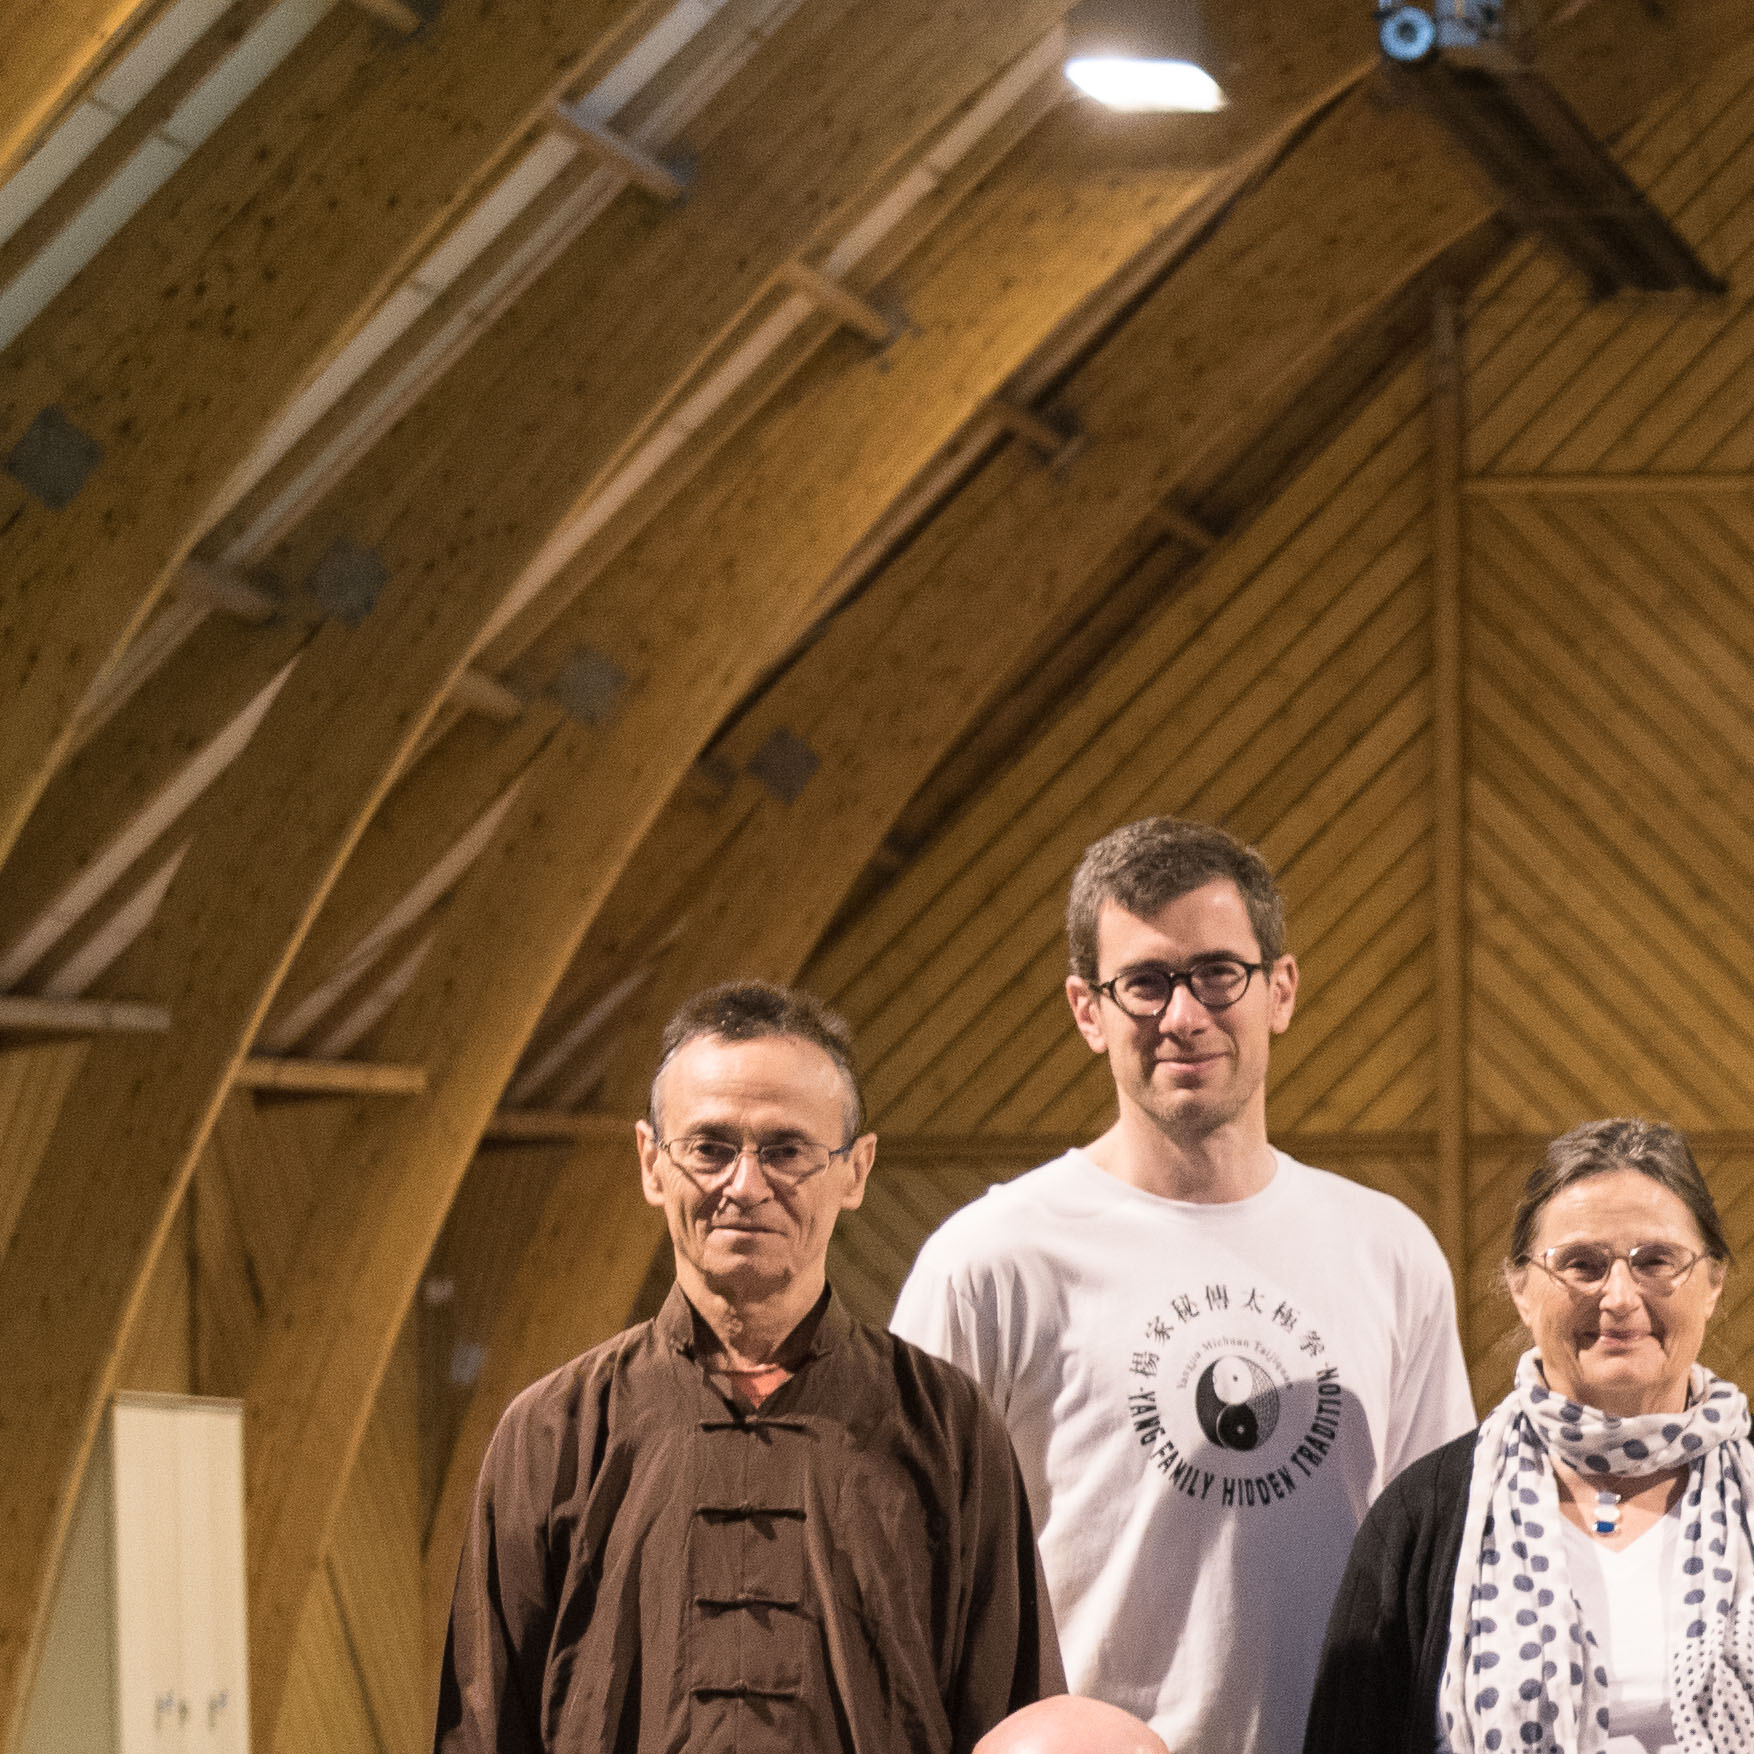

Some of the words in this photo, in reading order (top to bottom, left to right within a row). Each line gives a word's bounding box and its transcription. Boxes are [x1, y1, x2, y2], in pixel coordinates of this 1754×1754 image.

[1128, 1389, 1166, 1446] YANG
[1151, 1440, 1214, 1500] FAMILY
[1221, 1464, 1298, 1507] HIDDEN
[1290, 1366, 1342, 1477] TRADITION
